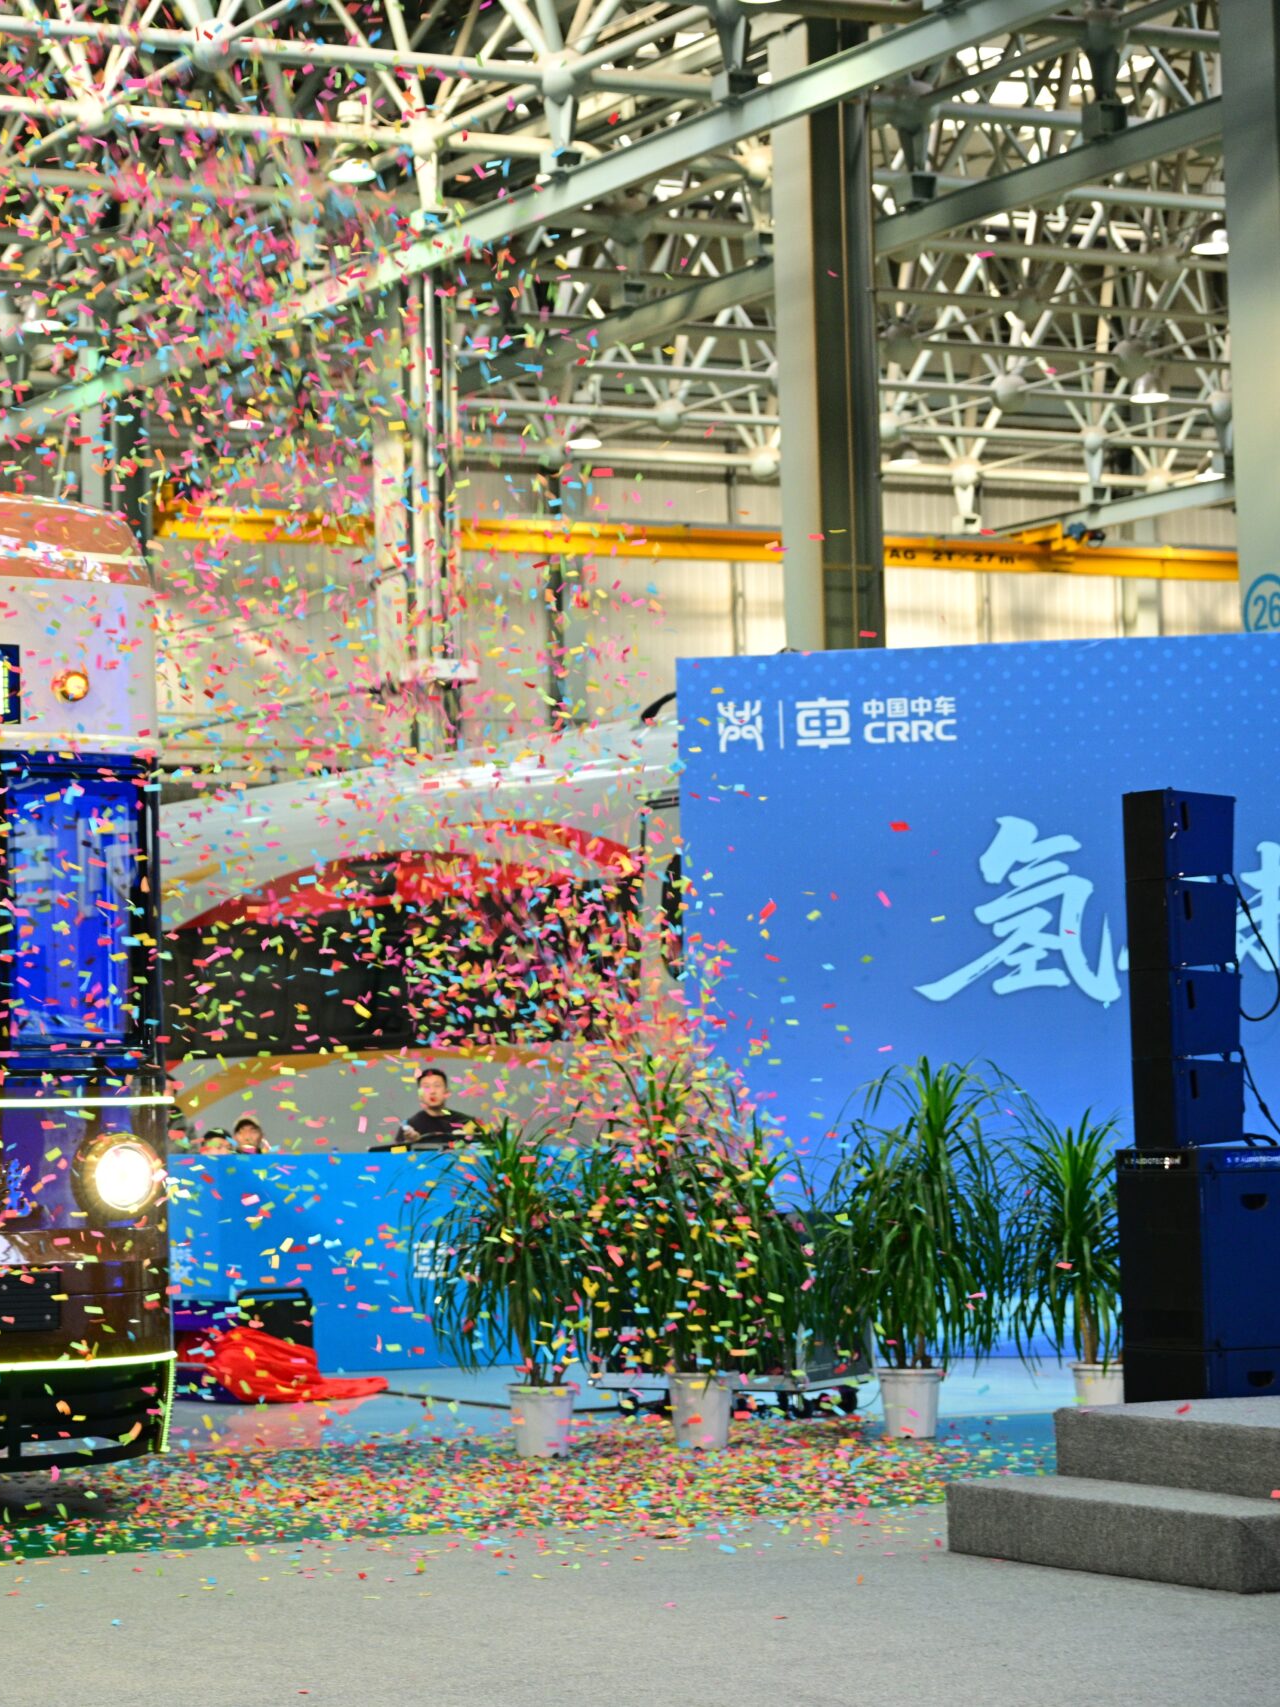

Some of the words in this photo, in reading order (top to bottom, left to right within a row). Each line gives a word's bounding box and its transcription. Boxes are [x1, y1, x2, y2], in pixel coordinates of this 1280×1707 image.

[1253, 591, 1280, 630] 26
[863, 696, 957, 719] 中国中车
[863, 719, 958, 744] CRRC
